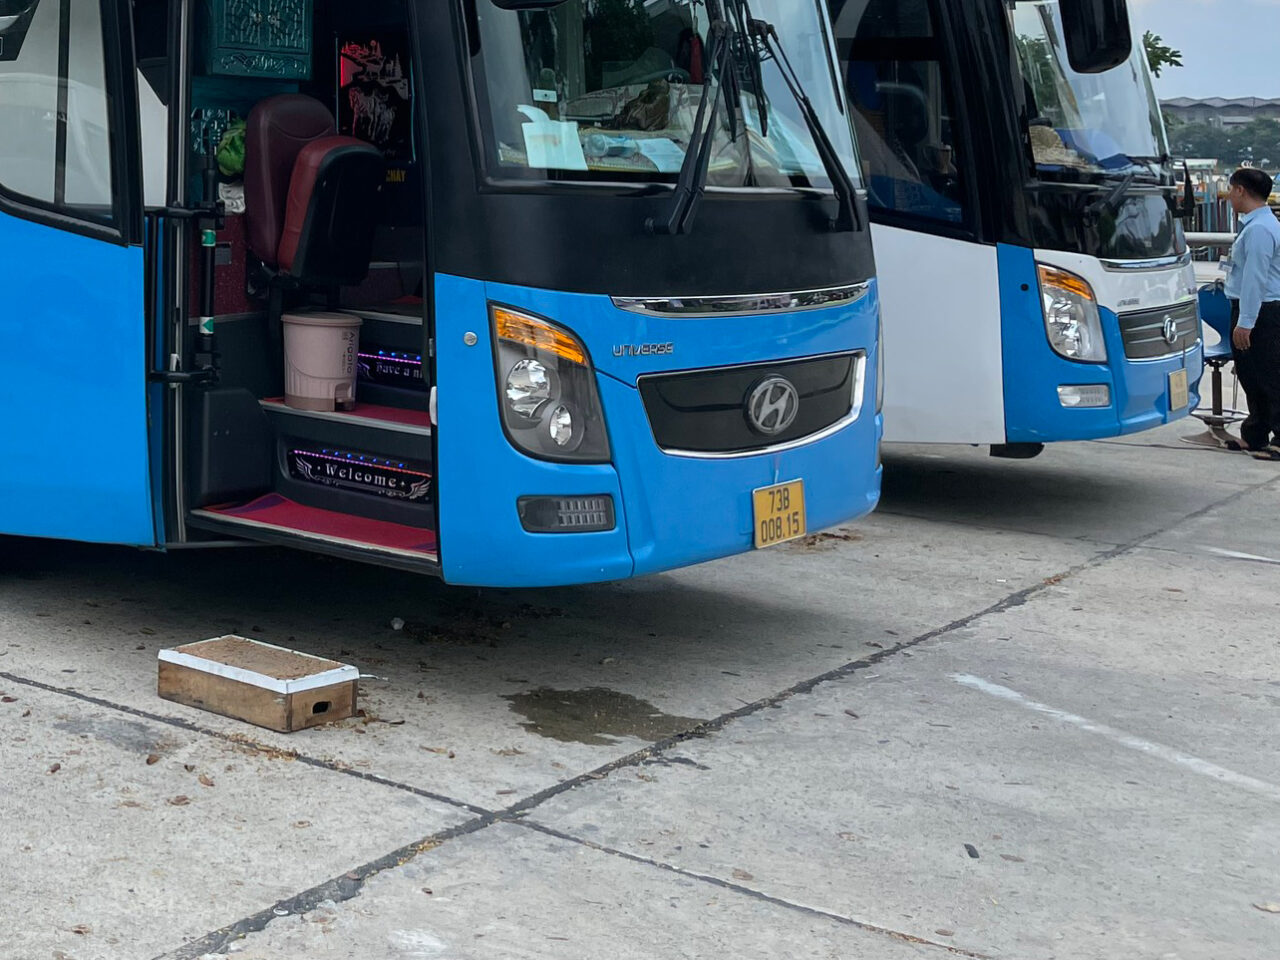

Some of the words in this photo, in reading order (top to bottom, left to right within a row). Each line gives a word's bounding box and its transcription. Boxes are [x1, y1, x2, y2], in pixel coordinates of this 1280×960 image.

[612, 341, 675, 358] UNIVERSE
[324, 463, 398, 488] Welcome
[768, 487, 790, 514] 73B
[761, 511, 800, 543] 008.15
